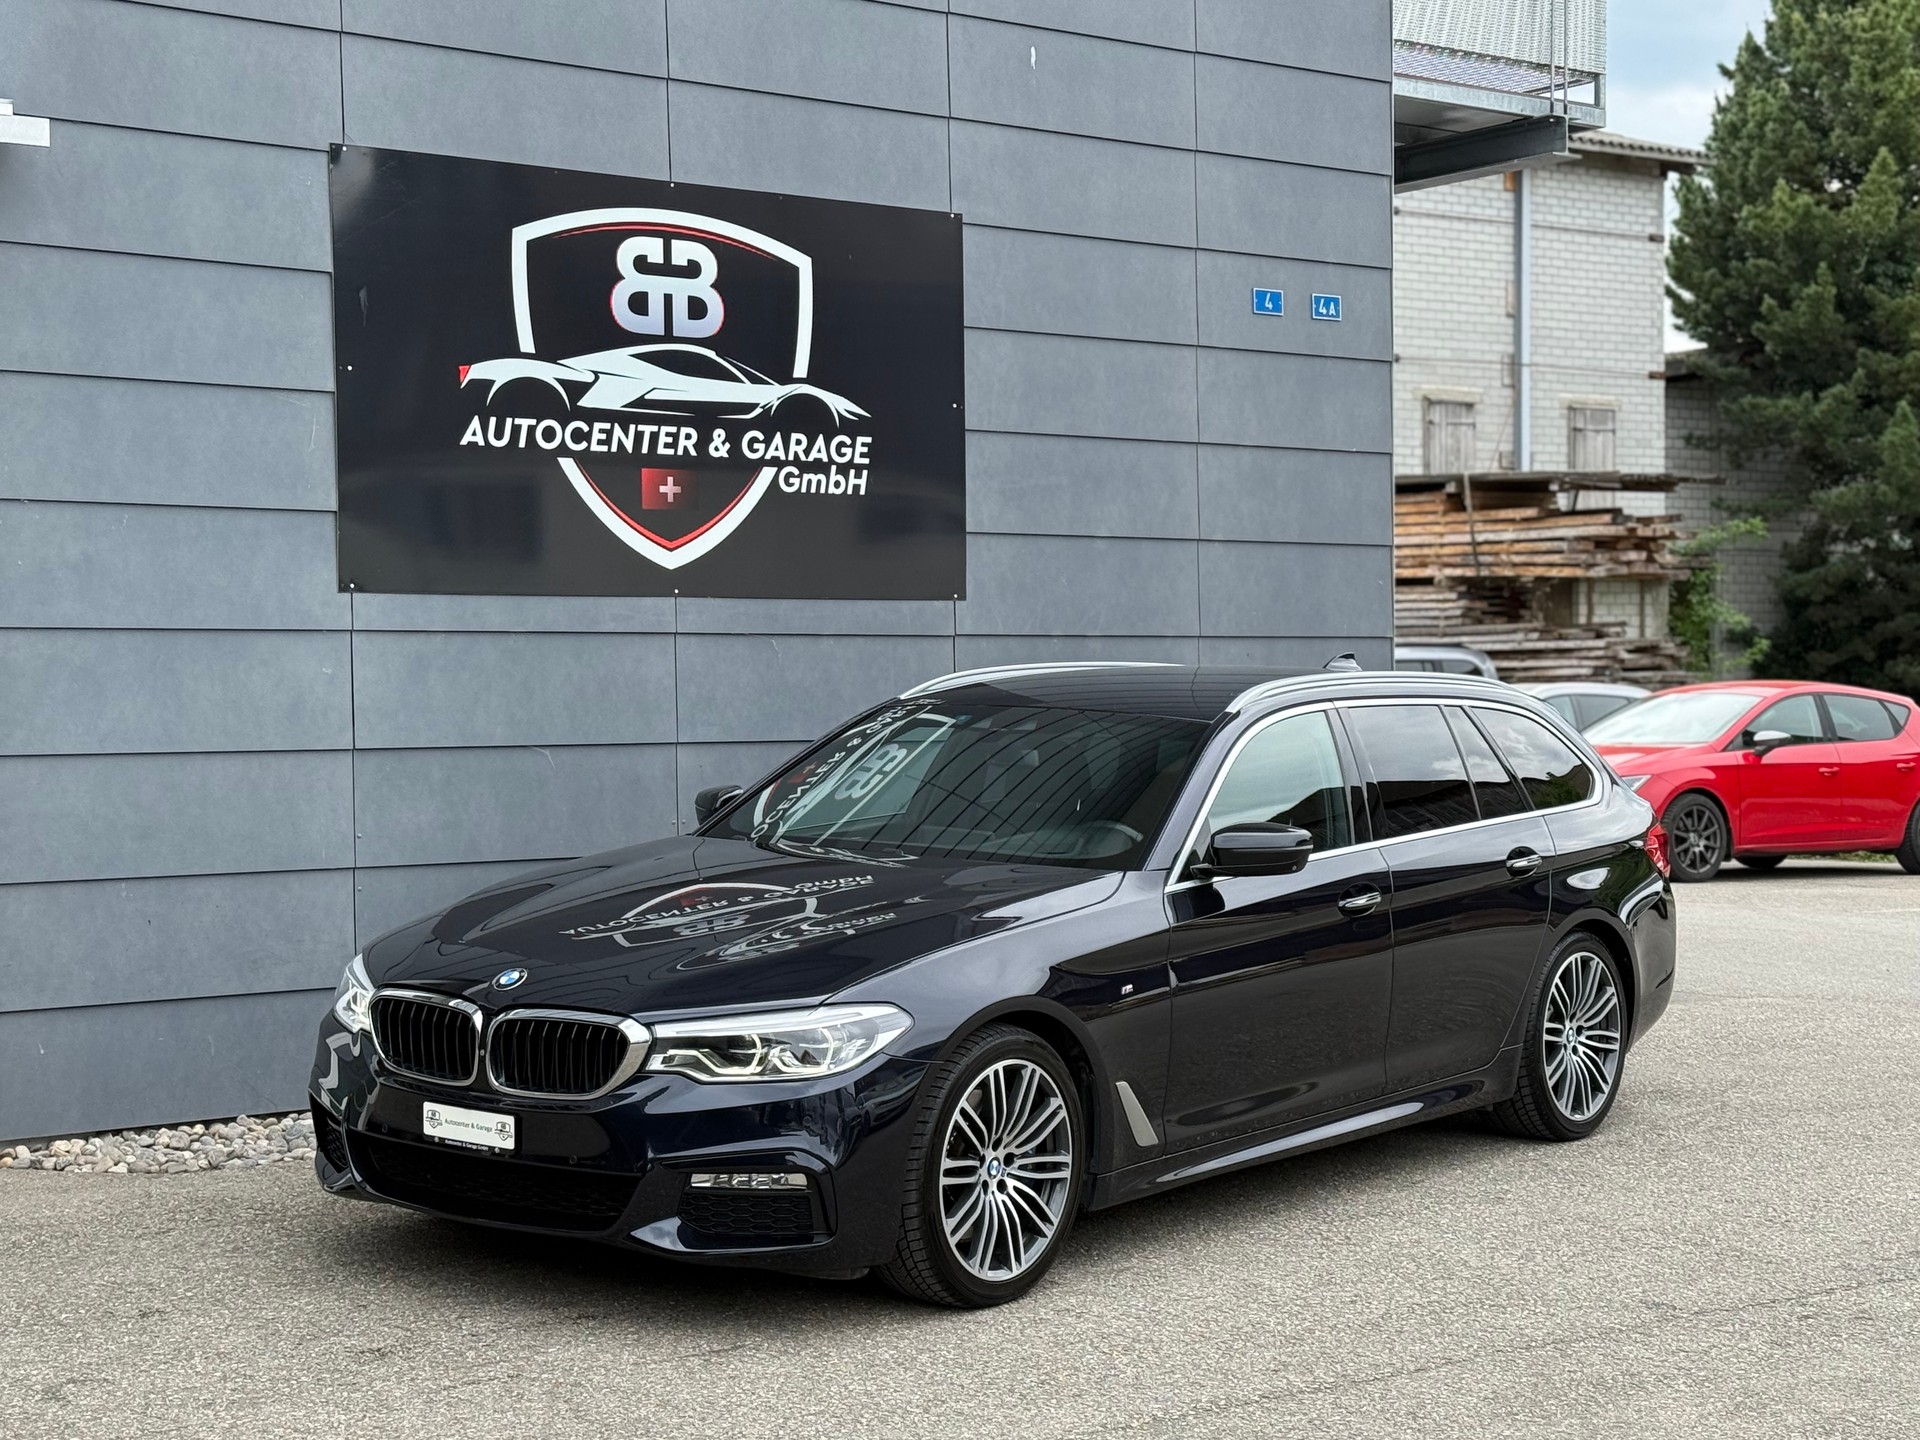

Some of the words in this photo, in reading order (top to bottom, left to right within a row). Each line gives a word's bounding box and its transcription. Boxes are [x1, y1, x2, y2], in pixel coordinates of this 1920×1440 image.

[1265, 293, 1273, 310] 4
[1319, 298, 1336, 316] 4A
[460, 415, 699, 457] AUTOCENTER
[708, 427, 731, 459] &
[742, 430, 873, 465] GARAGE
[778, 465, 868, 496] GmbH
[444, 1118, 470, 1129] Autocenter
